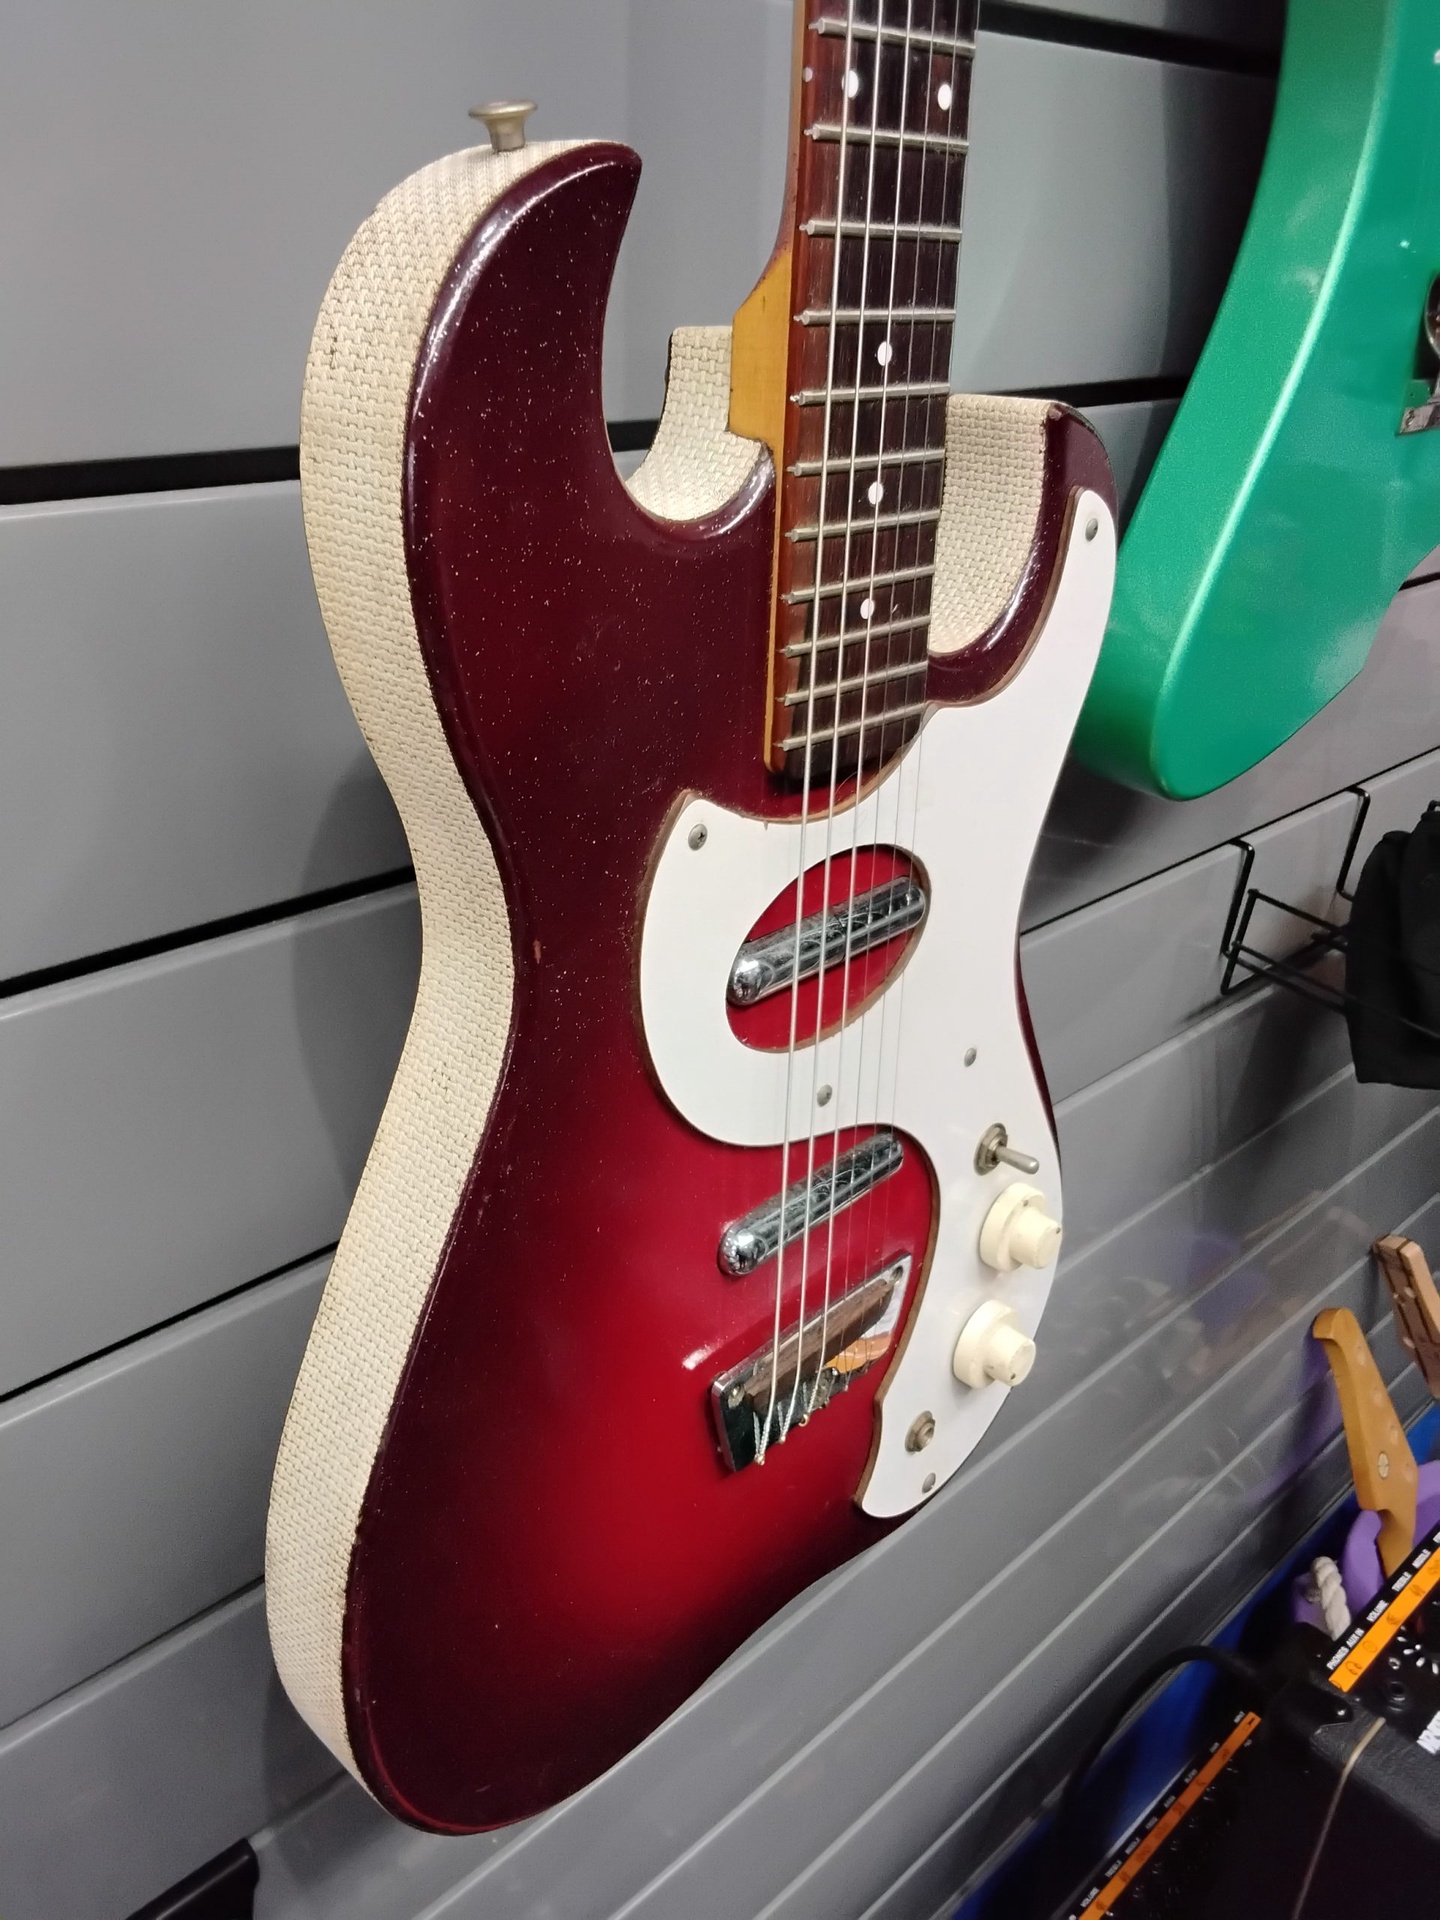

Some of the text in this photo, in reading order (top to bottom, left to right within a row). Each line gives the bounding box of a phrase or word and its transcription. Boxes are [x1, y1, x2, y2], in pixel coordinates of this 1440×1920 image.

[1326, 1646, 1350, 1671] PHONES
[1346, 1632, 1359, 1649] AUX
[1355, 1627, 1365, 1639] IN
[1366, 1599, 1389, 1622] VOLUME
[1391, 1571, 1412, 1592] TREBLE
